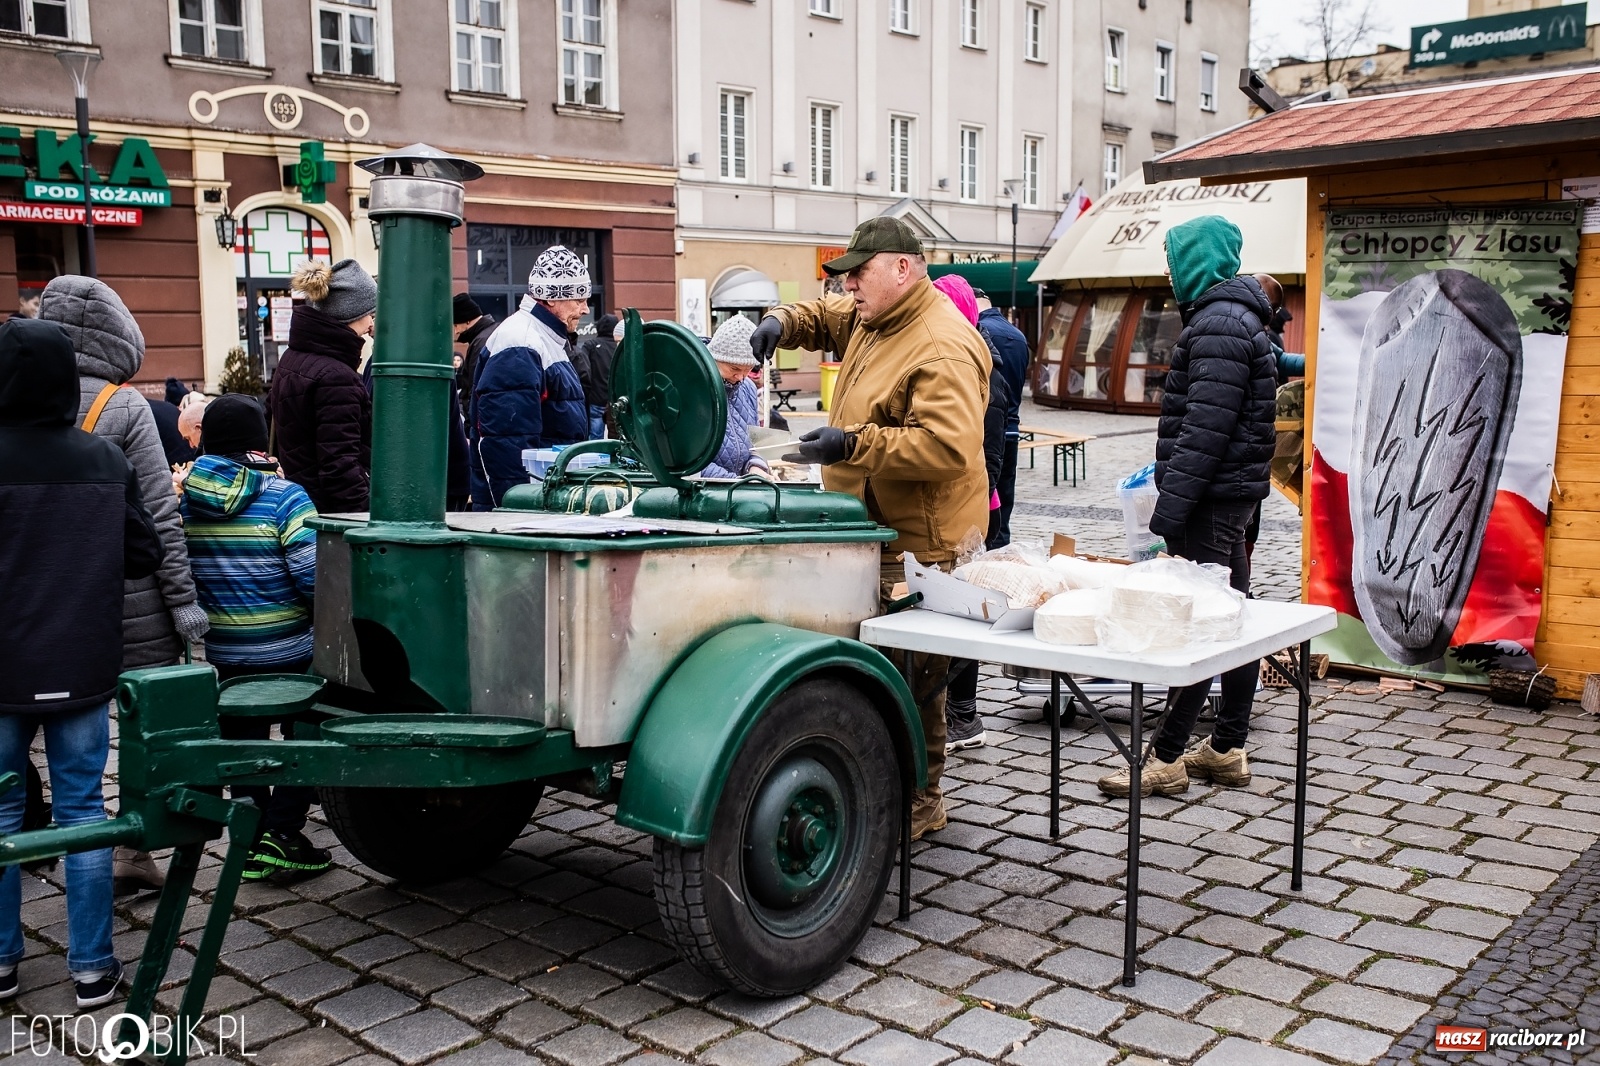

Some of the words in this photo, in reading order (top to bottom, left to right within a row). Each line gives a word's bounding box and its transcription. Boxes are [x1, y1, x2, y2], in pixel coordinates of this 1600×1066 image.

[1450, 25, 1540, 49] McDonald's
[273, 102, 295, 115] 1953
[34, 185, 79, 199] POD
[90, 187, 165, 204] RÓŻAMI
[1330, 214, 1375, 227] Grupa
[1380, 209, 1479, 225] Rekonstrukcji
[1484, 208, 1578, 224] Historycznej
[1107, 219, 1161, 245] 1567
[1341, 230, 1465, 257] Chłopcy
[1475, 235, 1489, 252] z
[1499, 229, 1561, 254] lasu
